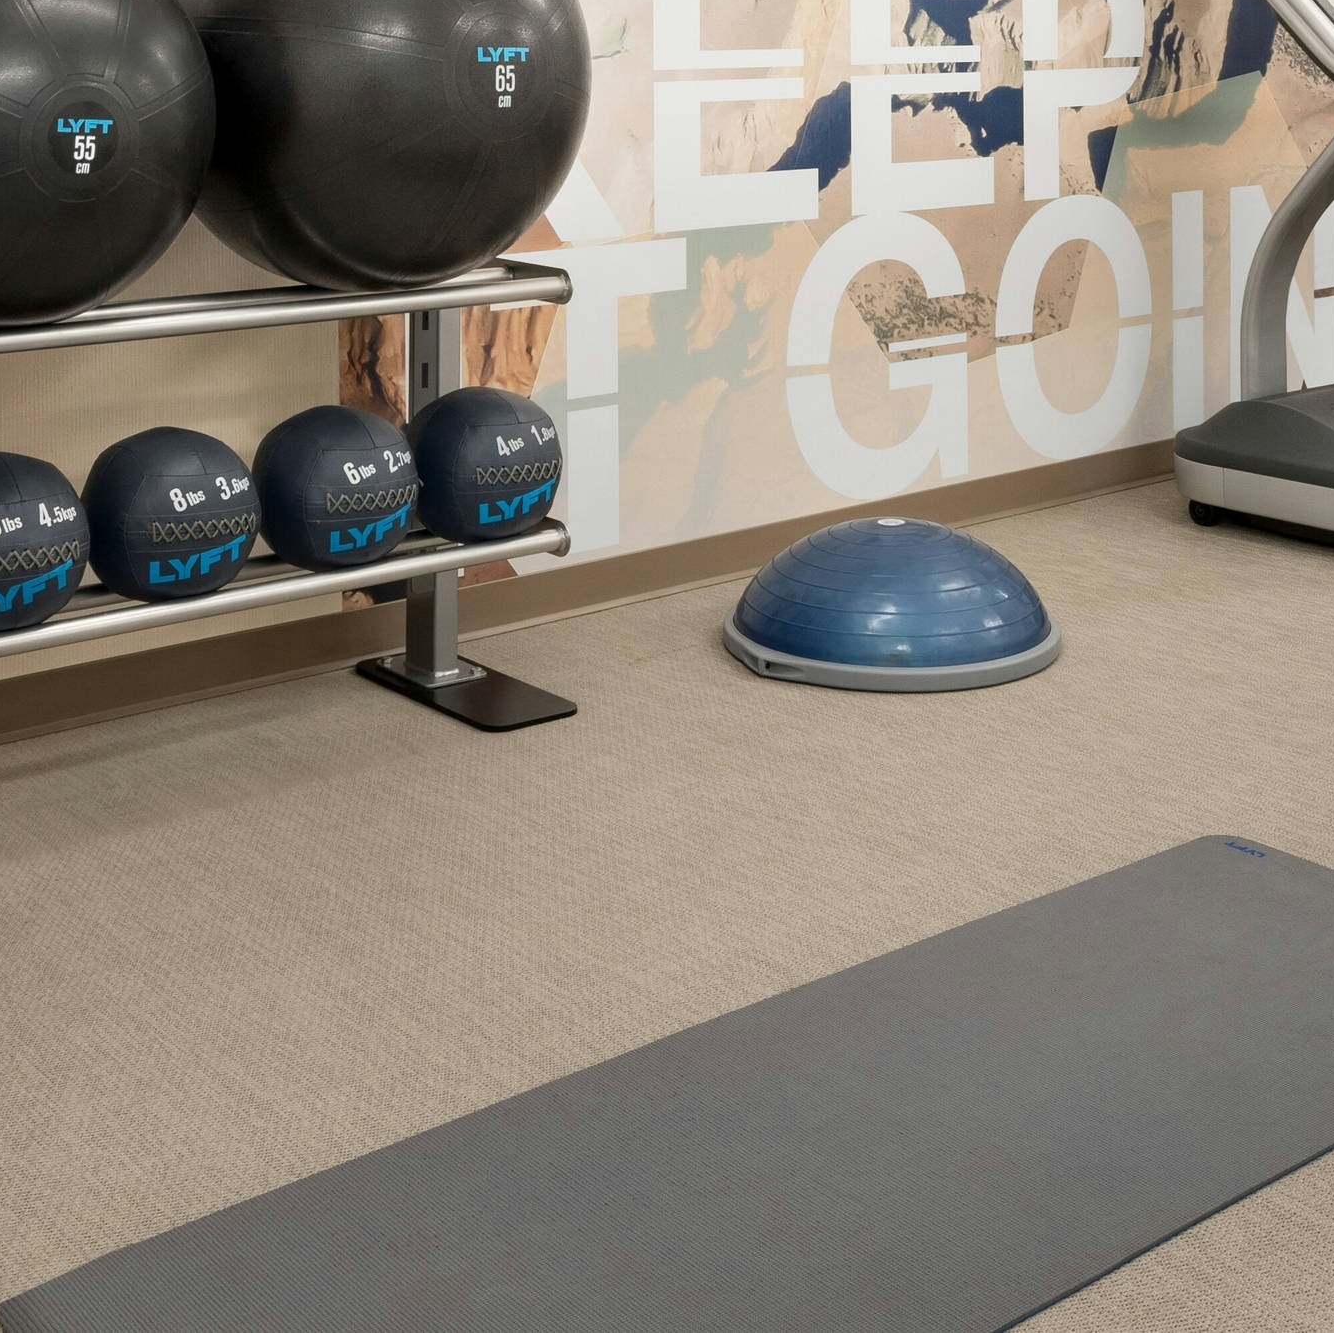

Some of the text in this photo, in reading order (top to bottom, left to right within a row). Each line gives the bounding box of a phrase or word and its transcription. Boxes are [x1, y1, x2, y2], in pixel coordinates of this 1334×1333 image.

[477, 46, 530, 63] LYFT
[495, 64, 516, 93] 65
[498, 95, 512, 108] cm
[57, 118, 114, 134] LYFT
[73, 135, 96, 161] 55
[75, 162, 91, 174] cm
[479, 477, 558, 525] LYFT
[330, 502, 412, 554] LYFT
[149, 533, 247, 585] LYFT
